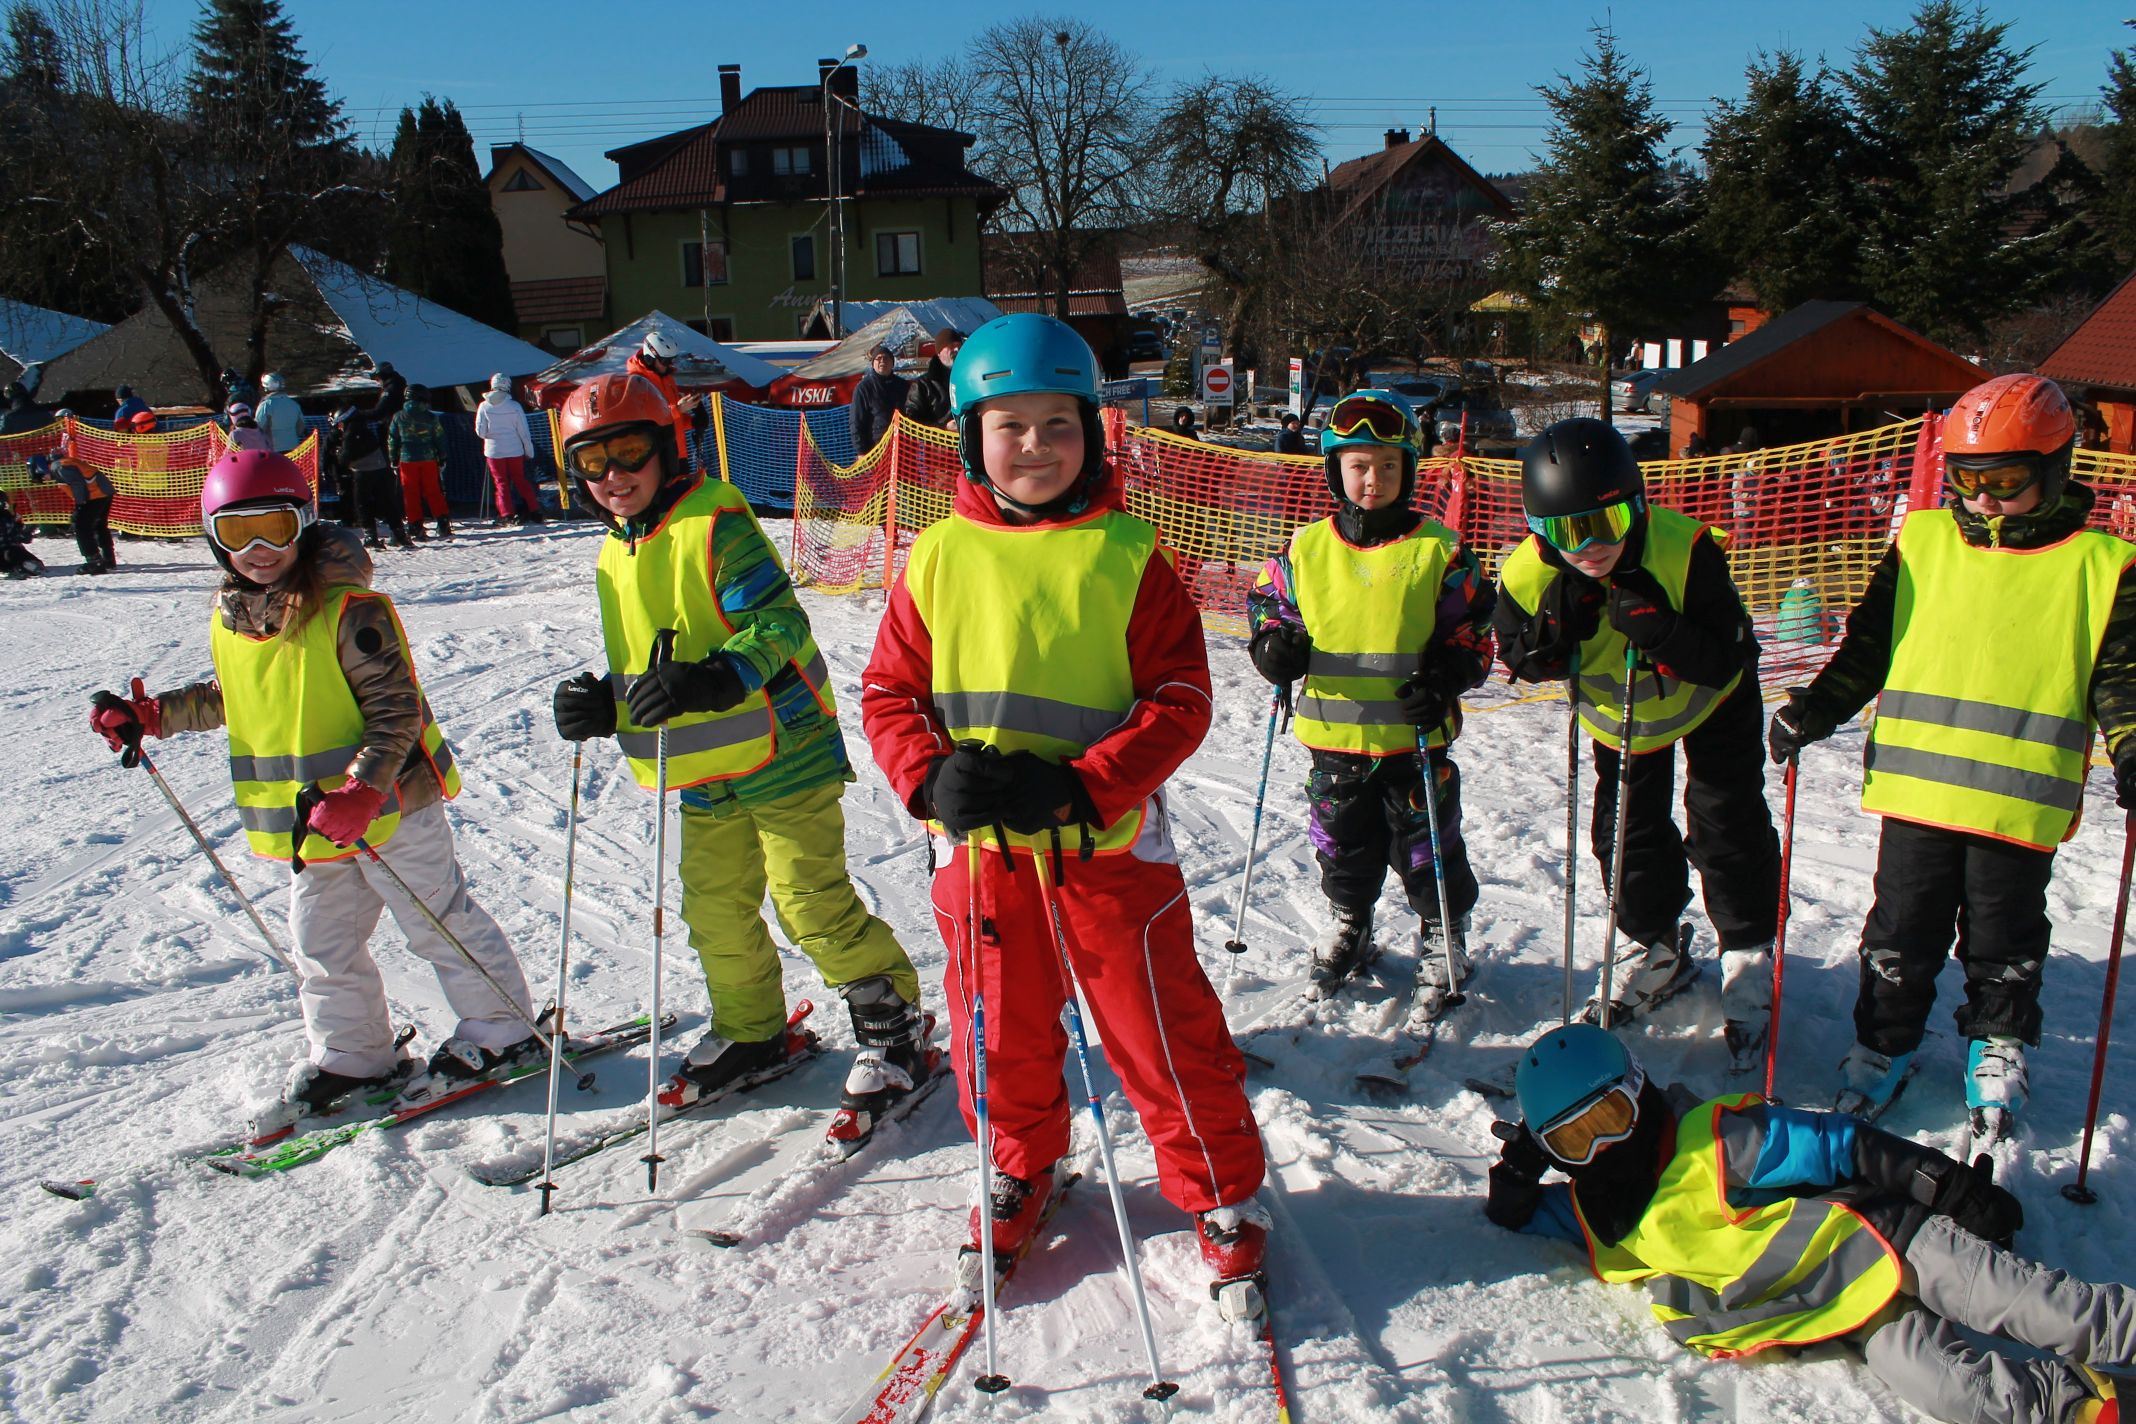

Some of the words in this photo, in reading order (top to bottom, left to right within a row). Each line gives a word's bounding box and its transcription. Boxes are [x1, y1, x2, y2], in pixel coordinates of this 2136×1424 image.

[1351, 225, 1463, 243] PIZZERIA
[768, 286, 826, 309] Ann
[791, 385, 837, 403] TYSKIE
[1112, 385, 1131, 397] FREE
[977, 1026, 986, 1074] ARTIS
[1072, 1029, 1089, 1079] ARTIS
